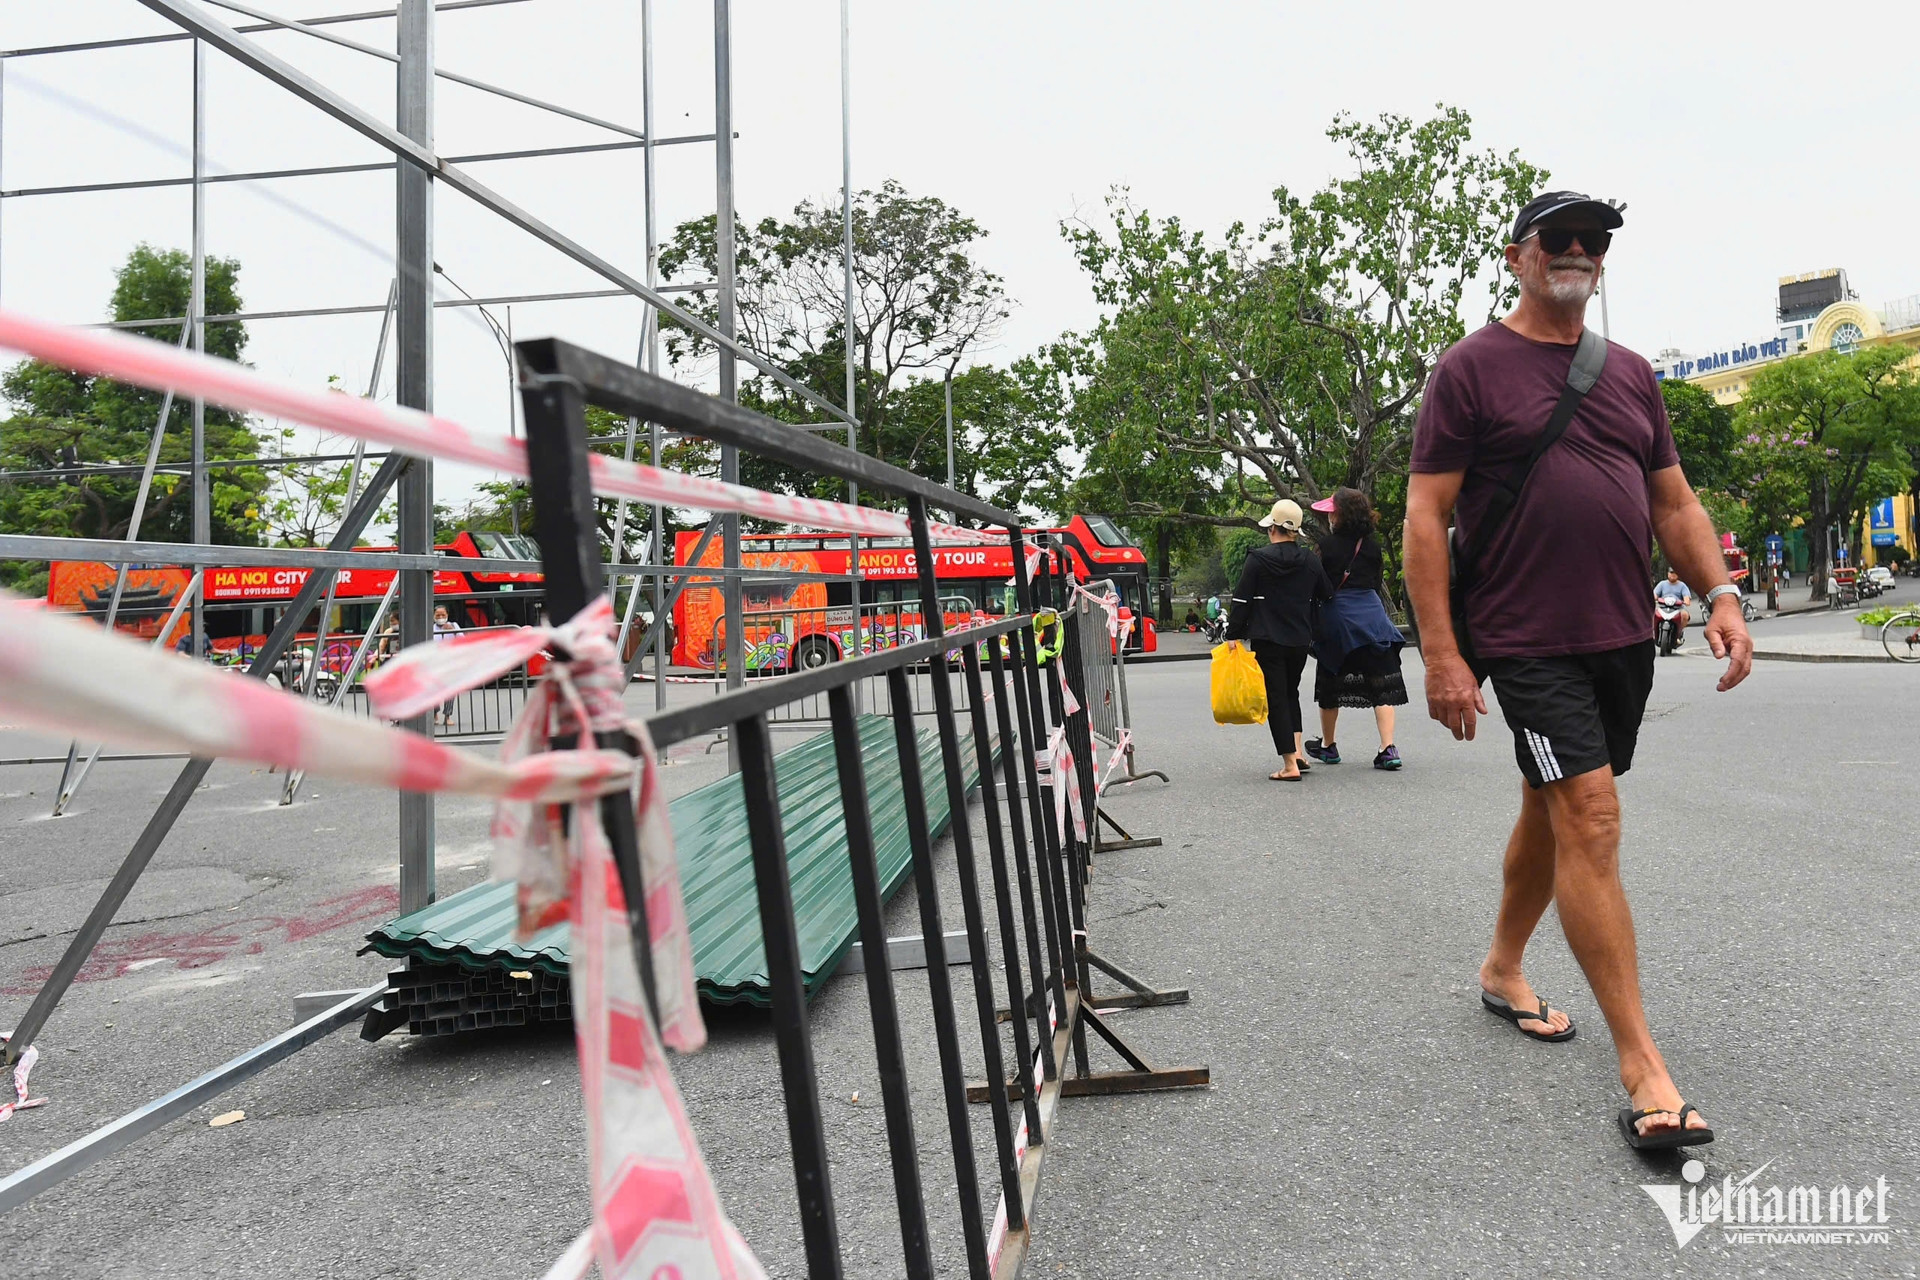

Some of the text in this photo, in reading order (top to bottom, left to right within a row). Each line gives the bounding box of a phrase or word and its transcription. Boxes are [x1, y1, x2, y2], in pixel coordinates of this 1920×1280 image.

[1672, 337, 1788, 379] TẬP ĐOÀN BẢO VIỆT
[904, 554, 940, 567] CY
[944, 552, 986, 565] TOUR
[868, 567, 881, 575] 091
[883, 567, 895, 575] 193
[896, 566, 906, 574] 82
[215, 573, 238, 586] HA
[241, 572, 268, 585] NOI
[274, 571, 308, 584] CITY
